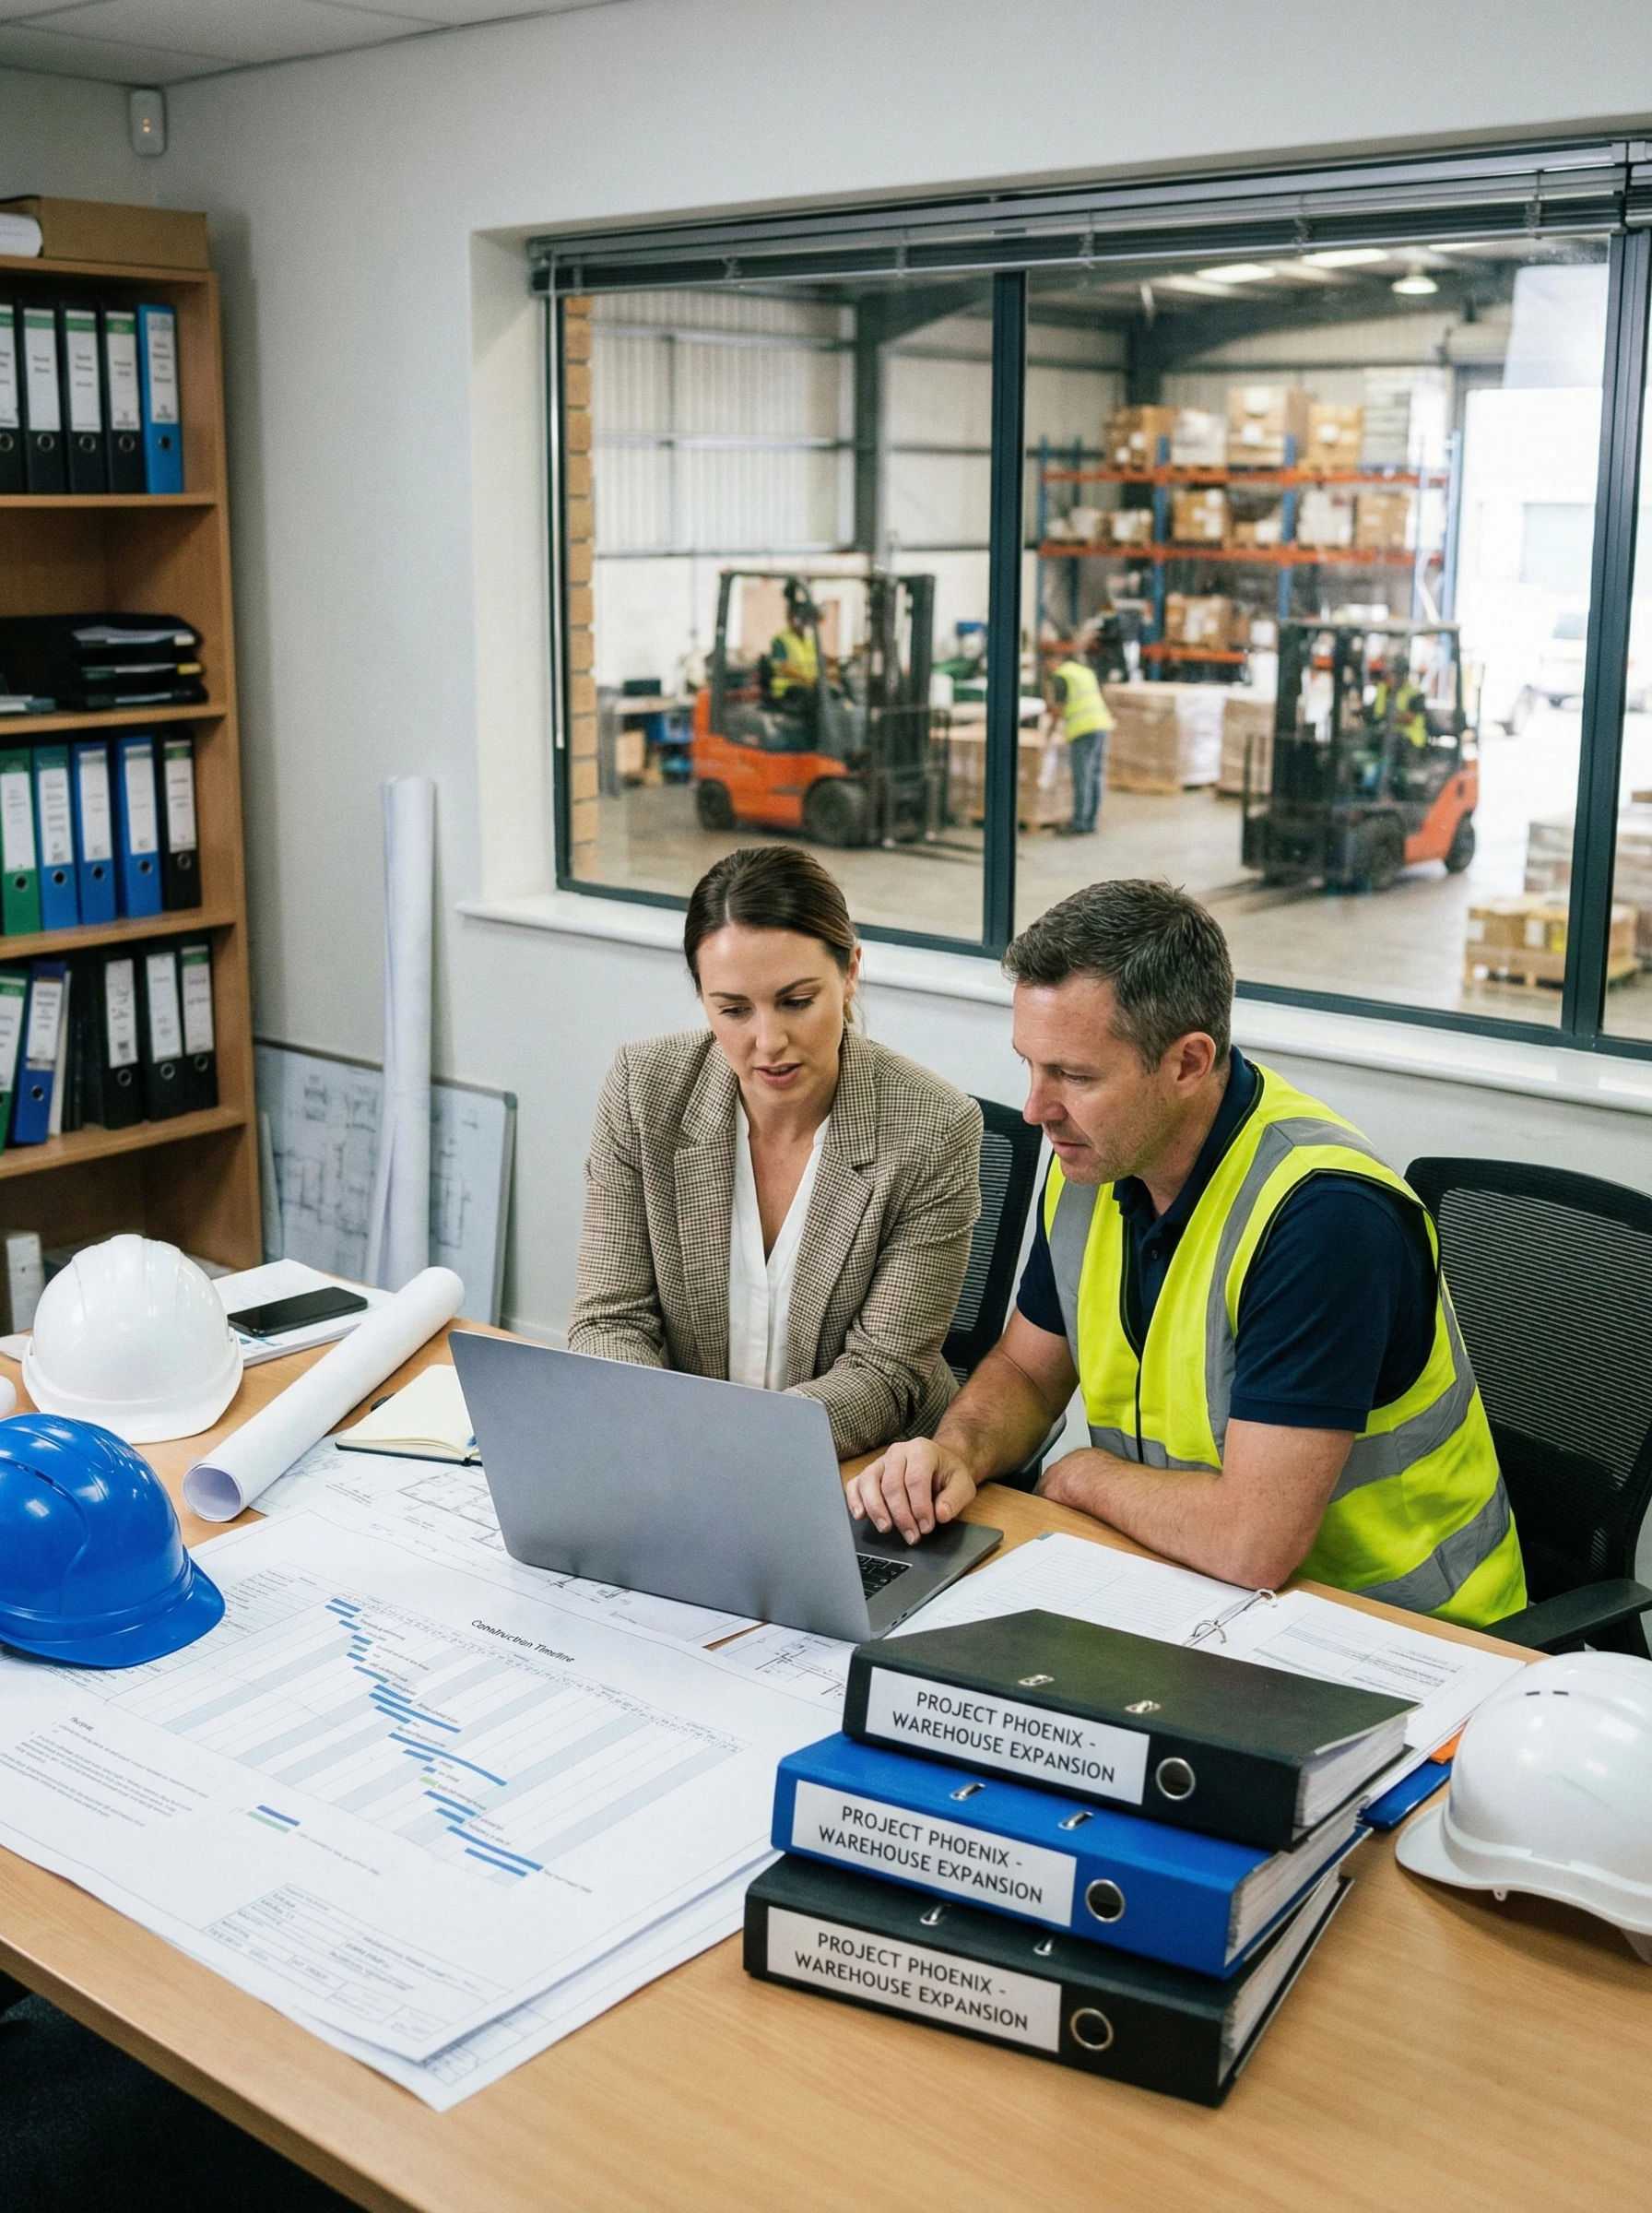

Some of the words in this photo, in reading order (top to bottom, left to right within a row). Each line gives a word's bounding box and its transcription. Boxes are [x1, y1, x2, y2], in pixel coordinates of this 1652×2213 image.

[891, 1710, 1004, 1754] WAREHOUSE
[1009, 1741, 1115, 1783] EXPANSION
[916, 1691, 997, 1725] PROJECT
[1002, 1712, 1083, 1748] PHOENIX
[819, 1825, 931, 1872] WAREHOUSE
[937, 1859, 1043, 1903] EXPANSION
[842, 1805, 923, 1841] PROJECT
[928, 1829, 1009, 1867] PHOENIX
[795, 1950, 912, 1998] WAREHOUSE
[918, 1985, 1028, 2030] EXPANSION
[818, 1932, 902, 1968] PROJECT
[908, 1957, 992, 1994] PHOENIX
